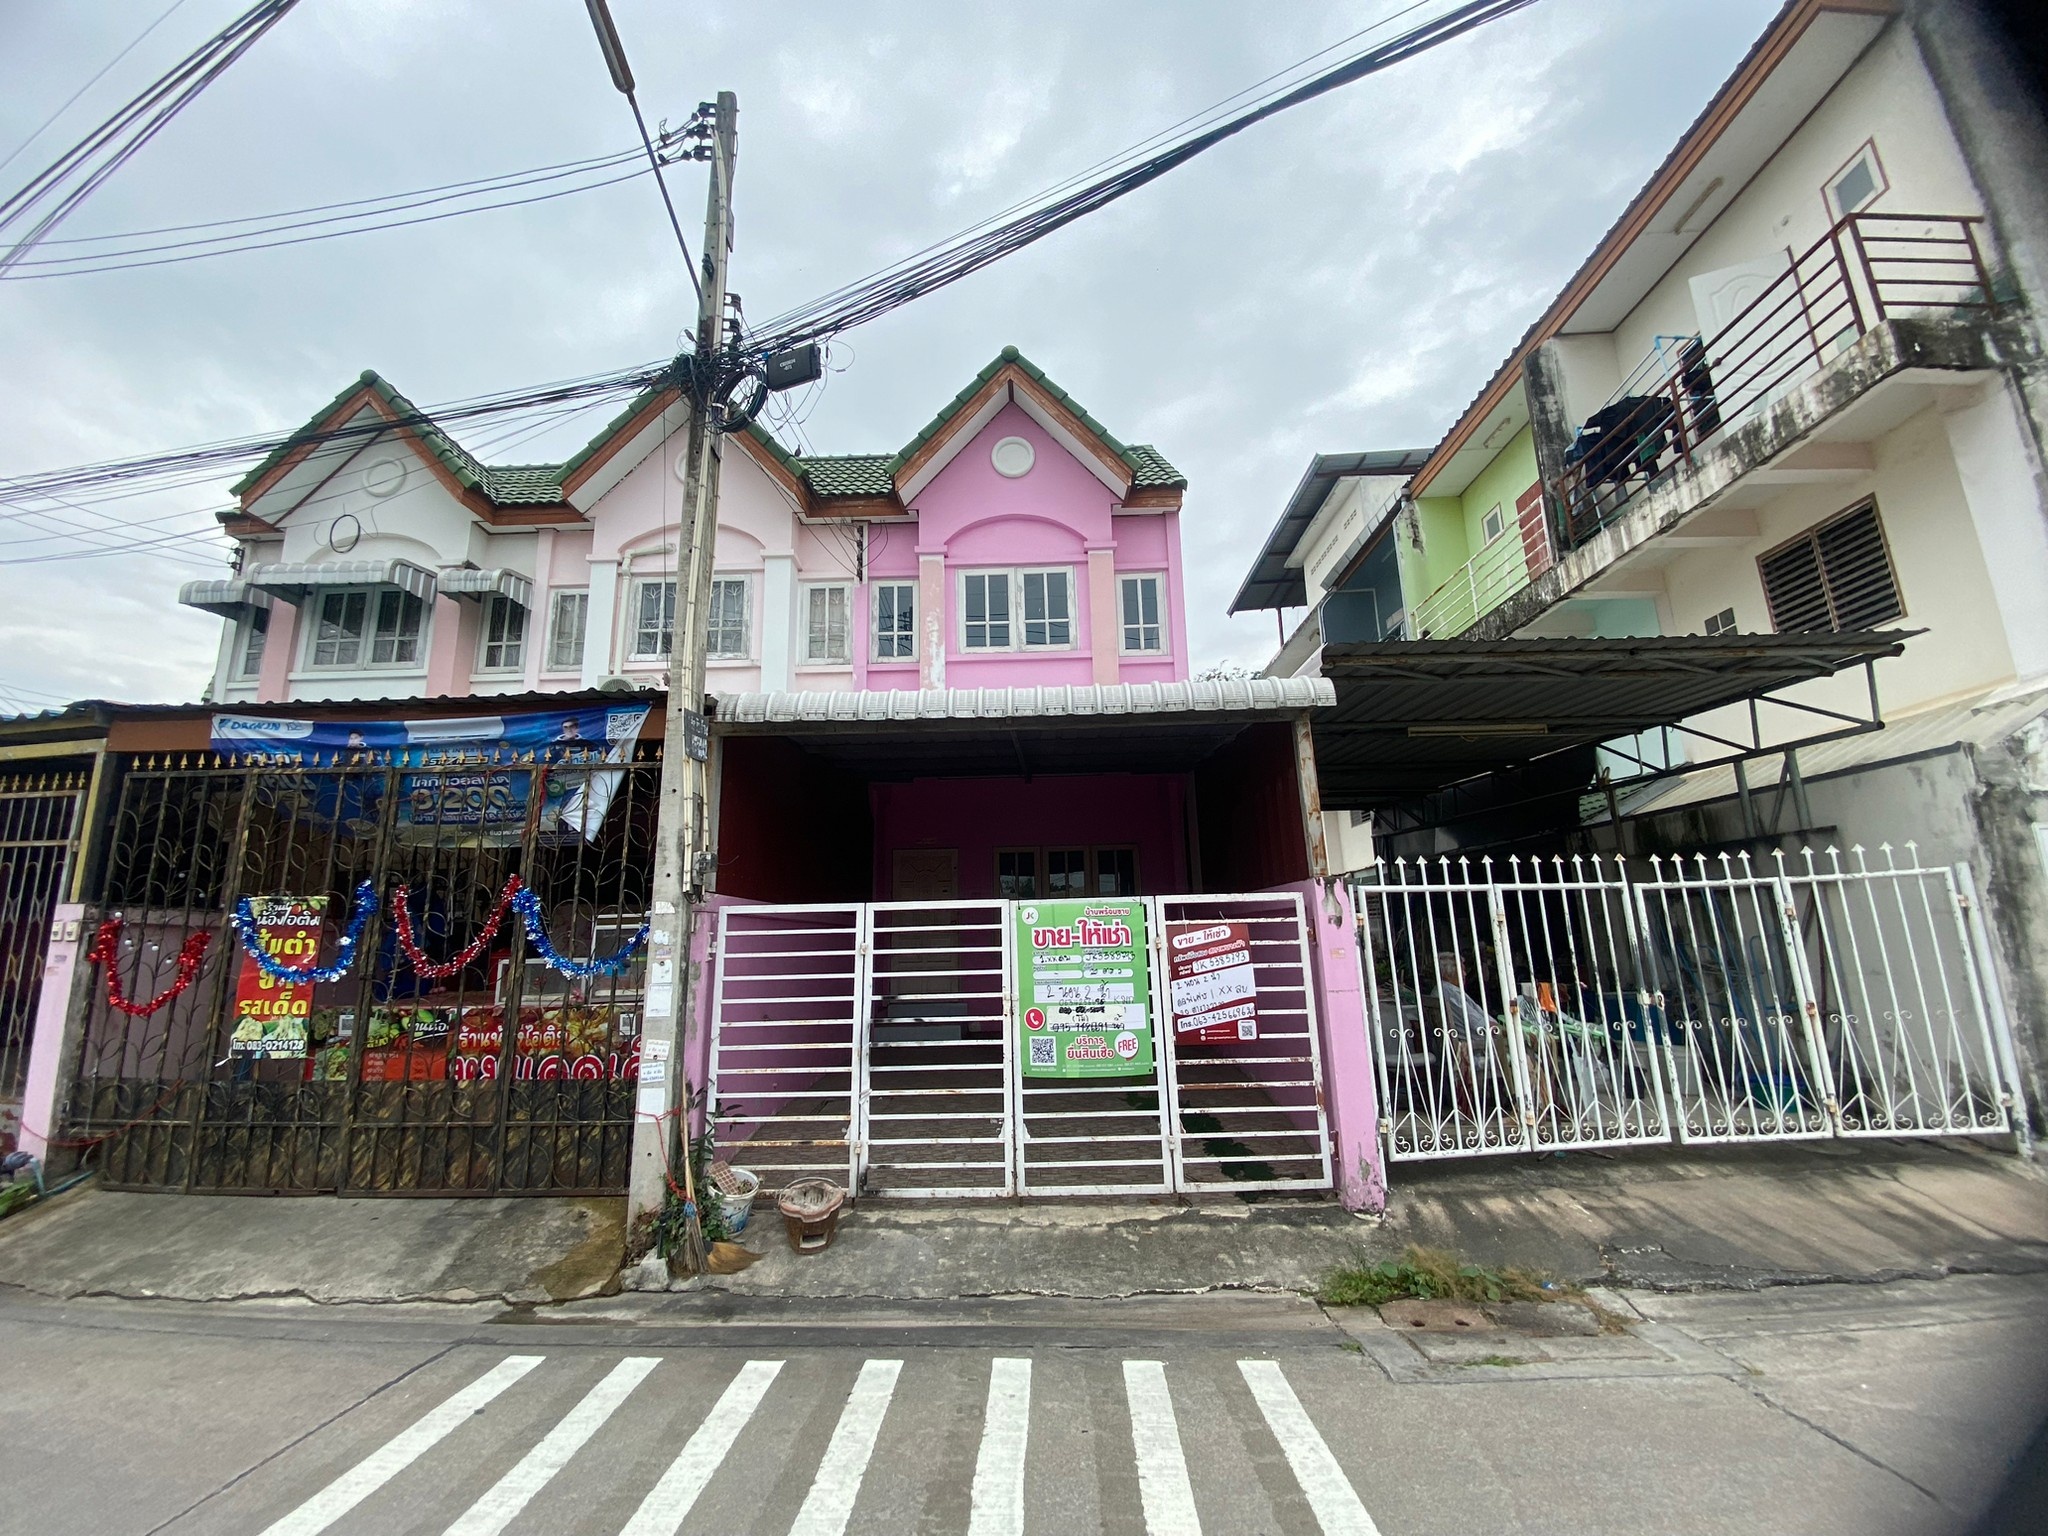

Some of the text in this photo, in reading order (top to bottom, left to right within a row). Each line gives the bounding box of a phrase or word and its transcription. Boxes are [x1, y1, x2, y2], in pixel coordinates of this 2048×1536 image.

[231, 721, 281, 731] DAIKIN
[1032, 919, 1132, 948] ขาย-ให้เช่า
[1203, 927, 1227, 940] ให้เช่า
[238, 991, 308, 1016] รสเด็ด
[1075, 1035, 1105, 1045] บริการ
[1117, 1037, 1137, 1053] FREE
[1067, 1044, 1115, 1059] ยื่นสินเชื่อ
